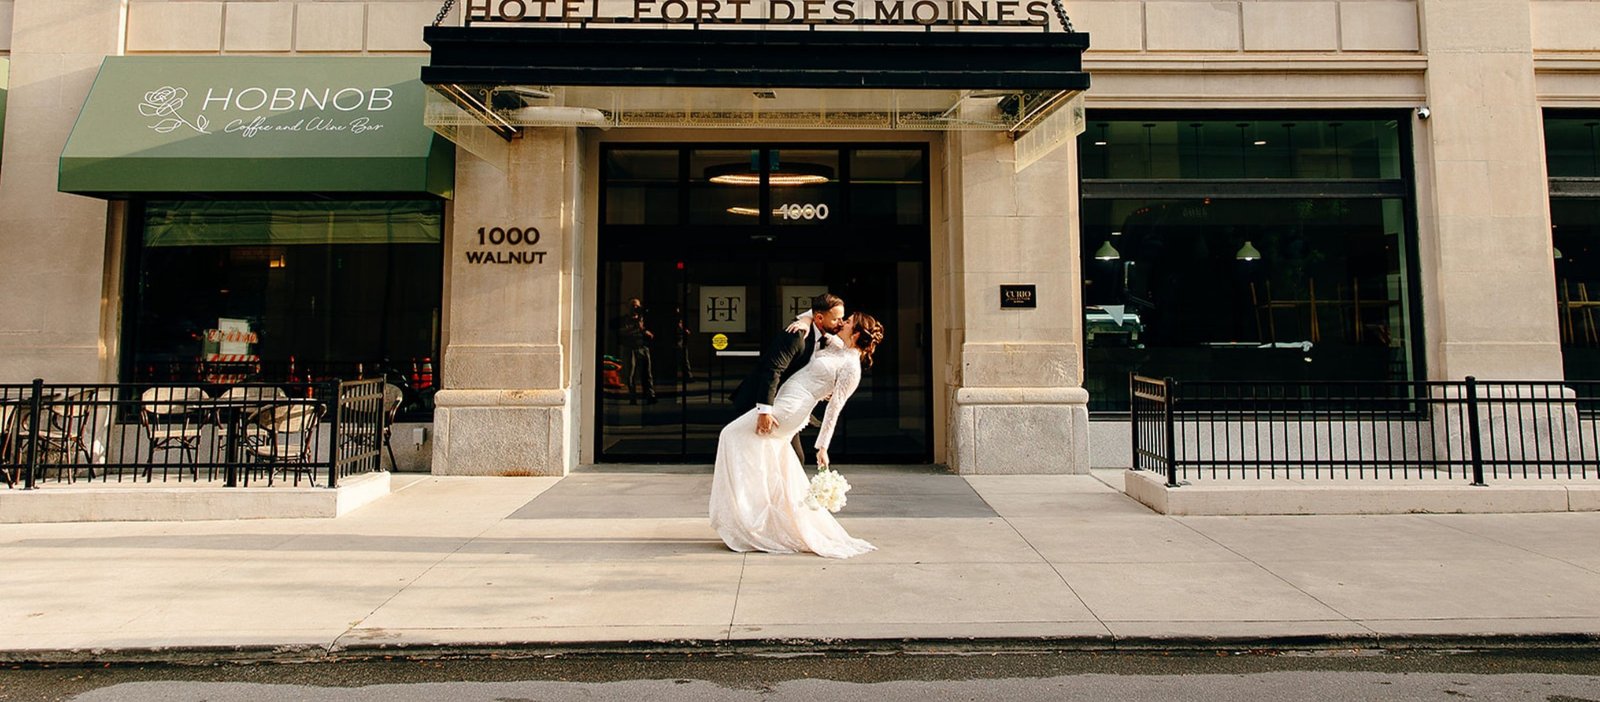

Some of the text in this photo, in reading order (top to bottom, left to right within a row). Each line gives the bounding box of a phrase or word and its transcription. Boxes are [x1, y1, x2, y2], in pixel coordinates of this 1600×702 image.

[465, 0, 1049, 25] HOTEL FORT DES MOINES
[202, 87, 394, 111] HOBNOB
[224, 116, 384, 138] Coffee and Wine Bar
[780, 203, 829, 220] 1000
[477, 227, 540, 245] 1000
[466, 251, 547, 264] WALNUT
